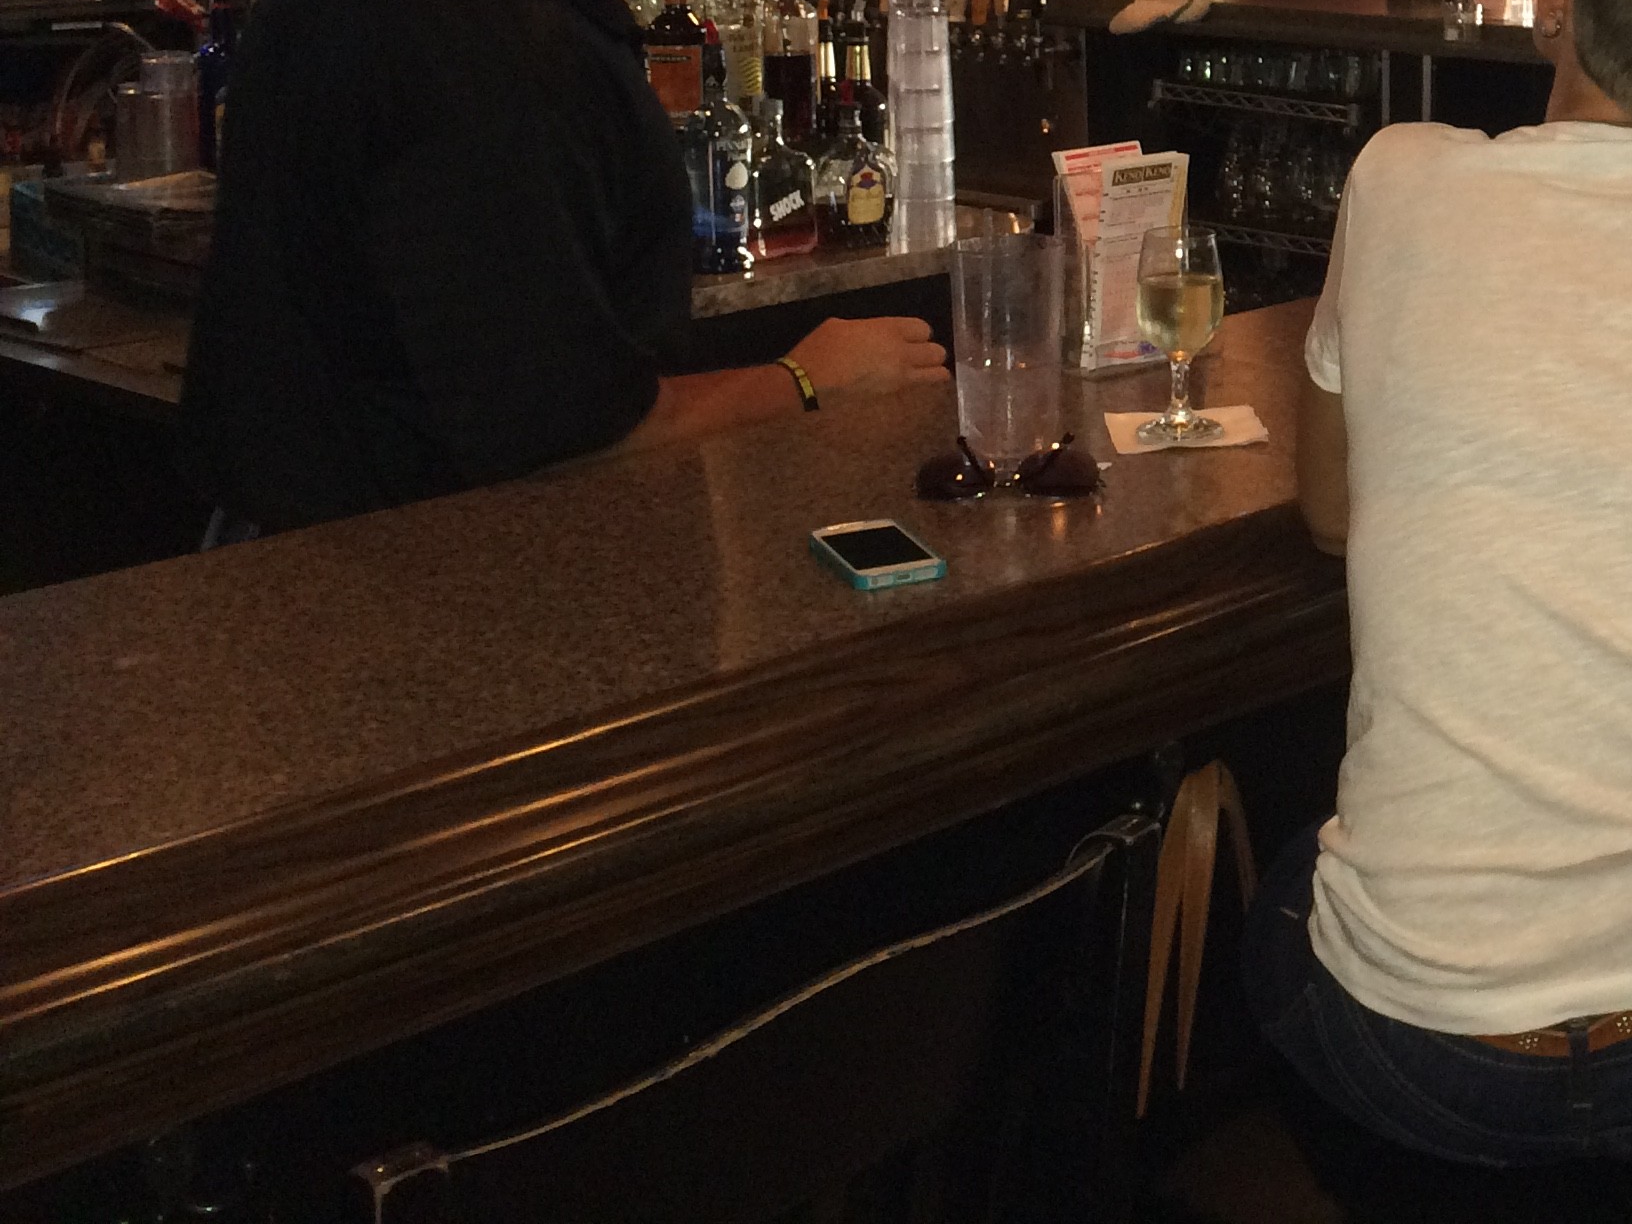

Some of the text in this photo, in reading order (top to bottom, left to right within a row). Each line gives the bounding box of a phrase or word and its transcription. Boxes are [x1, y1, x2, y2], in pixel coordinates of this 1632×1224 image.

[1114, 169, 1142, 184] KENO
[1145, 165, 1171, 179] KENO
[769, 189, 805, 222] SHOCK
